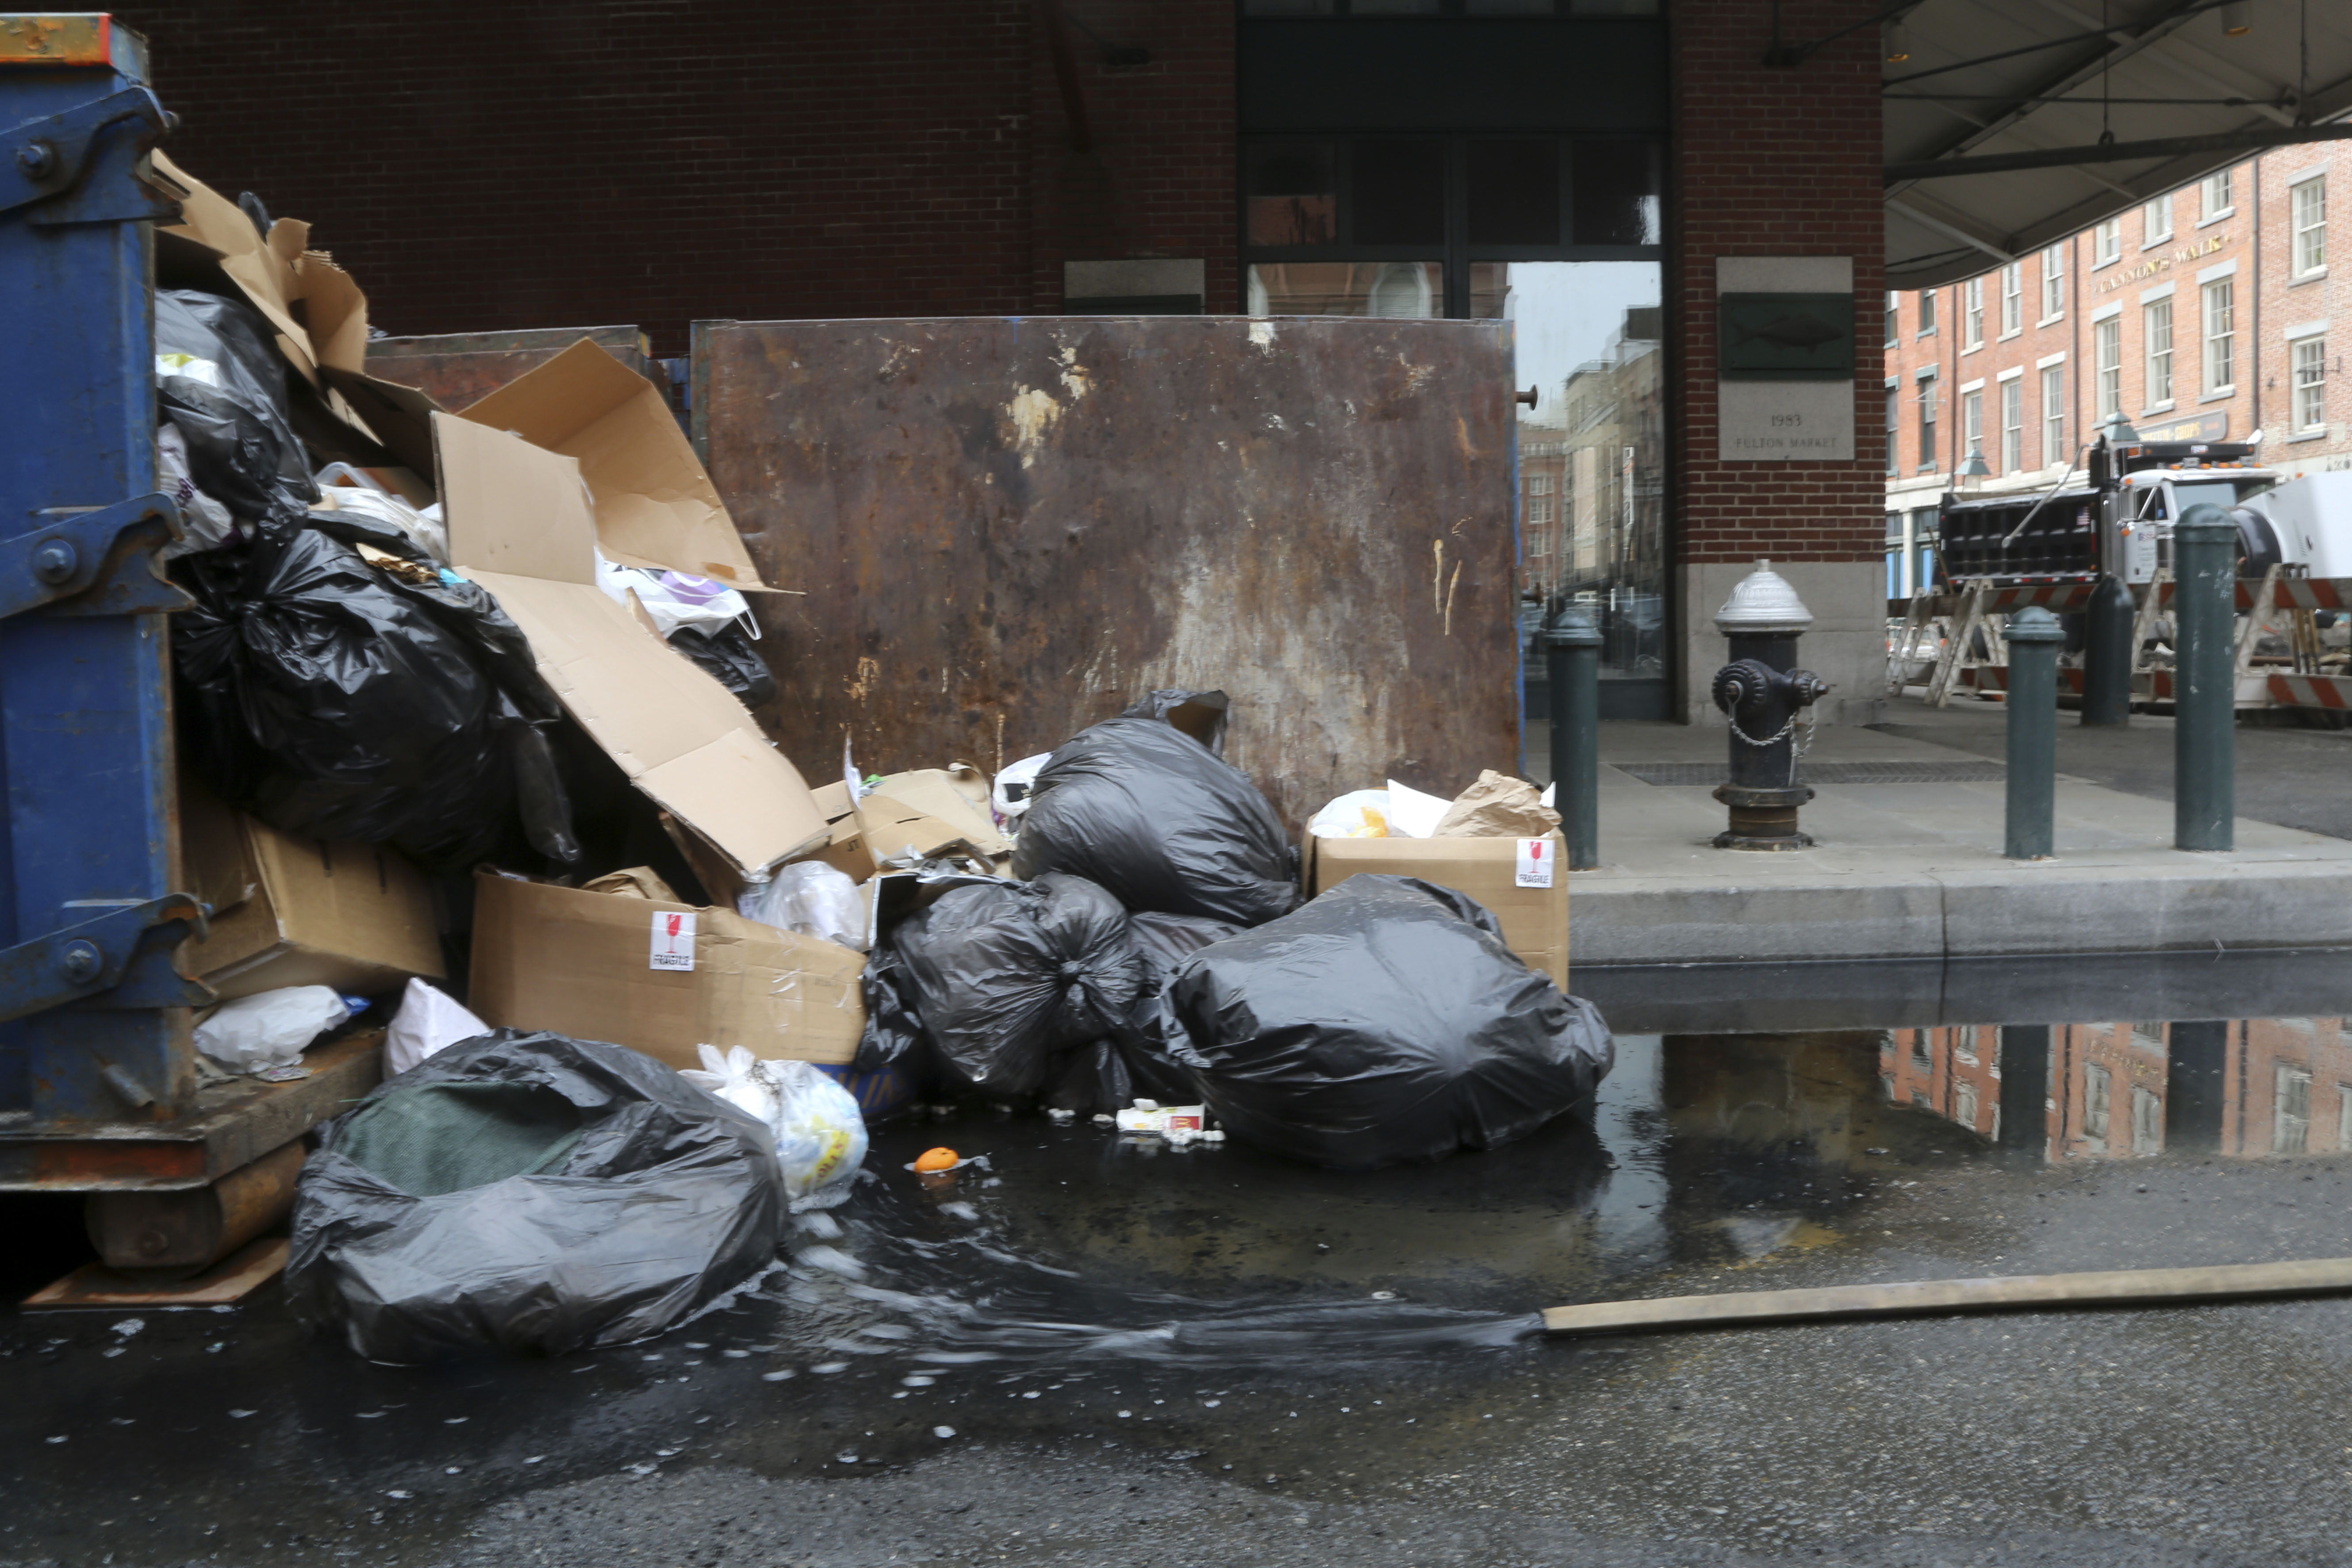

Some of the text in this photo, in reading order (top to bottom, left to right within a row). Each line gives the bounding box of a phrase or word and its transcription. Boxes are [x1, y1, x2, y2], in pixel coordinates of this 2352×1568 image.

[2100, 235, 2222, 294] CANNON'S WALK
[1771, 414, 1801, 426] 1983
[1736, 437, 1837, 449] FULTON MARKET
[1518, 874, 1550, 884] FRAGILE
[653, 954, 690, 966] FRAGILE
